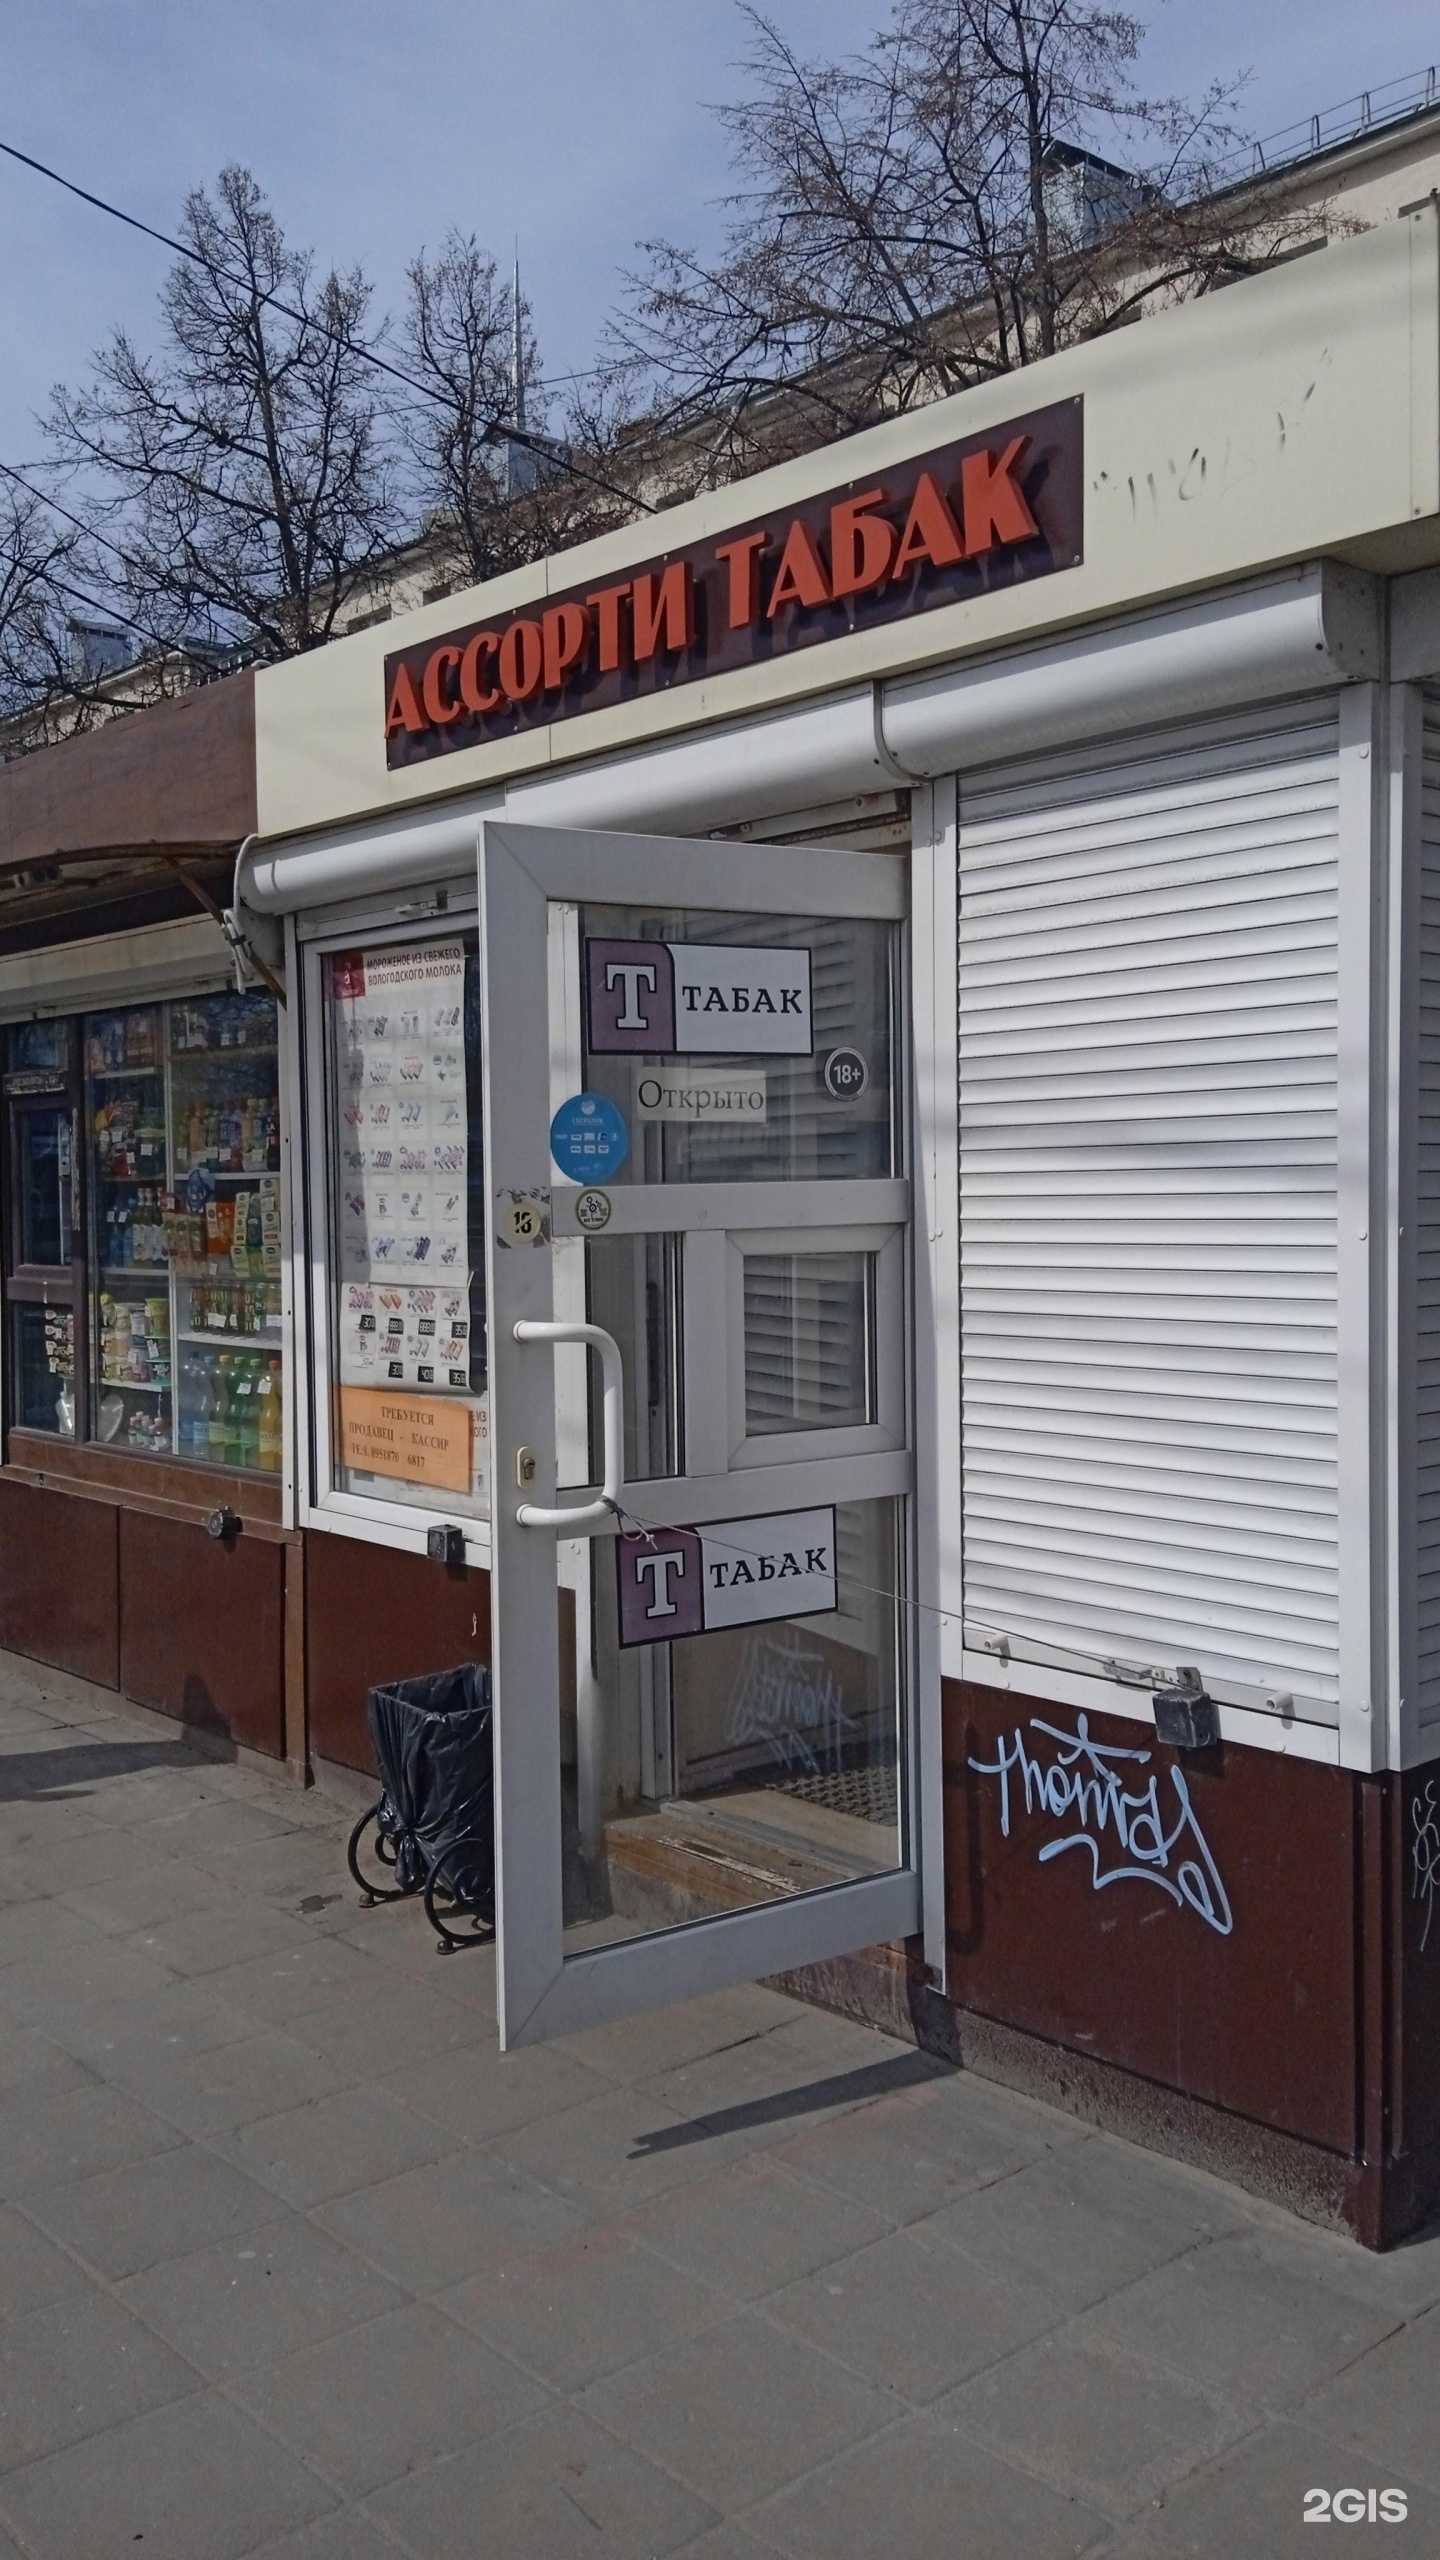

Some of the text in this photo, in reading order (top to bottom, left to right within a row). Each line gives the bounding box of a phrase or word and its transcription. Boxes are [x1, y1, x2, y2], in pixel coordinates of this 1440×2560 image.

[385, 561, 697, 739] АССОРТИ
[715, 435, 1040, 630] ТАБАК
[366, 947, 460, 970] МОРОЖЕНОЕ ИЗ СВЕЖЕГО
[368, 963, 463, 986] ВОЛОГОДСКОГО МОЛОКА
[682, 986, 803, 1014] ТАБАК
[833, 1064, 862, 1085] 18+
[638, 1079, 765, 1119] Открыто
[381, 1406, 434, 1426] ТРЕБУЕТСЯ
[349, 1422, 394, 1442] ПРОДАВЕЦ
[411, 1432, 449, 1451] КАССИР
[709, 1547, 828, 1589] ТАБАК
